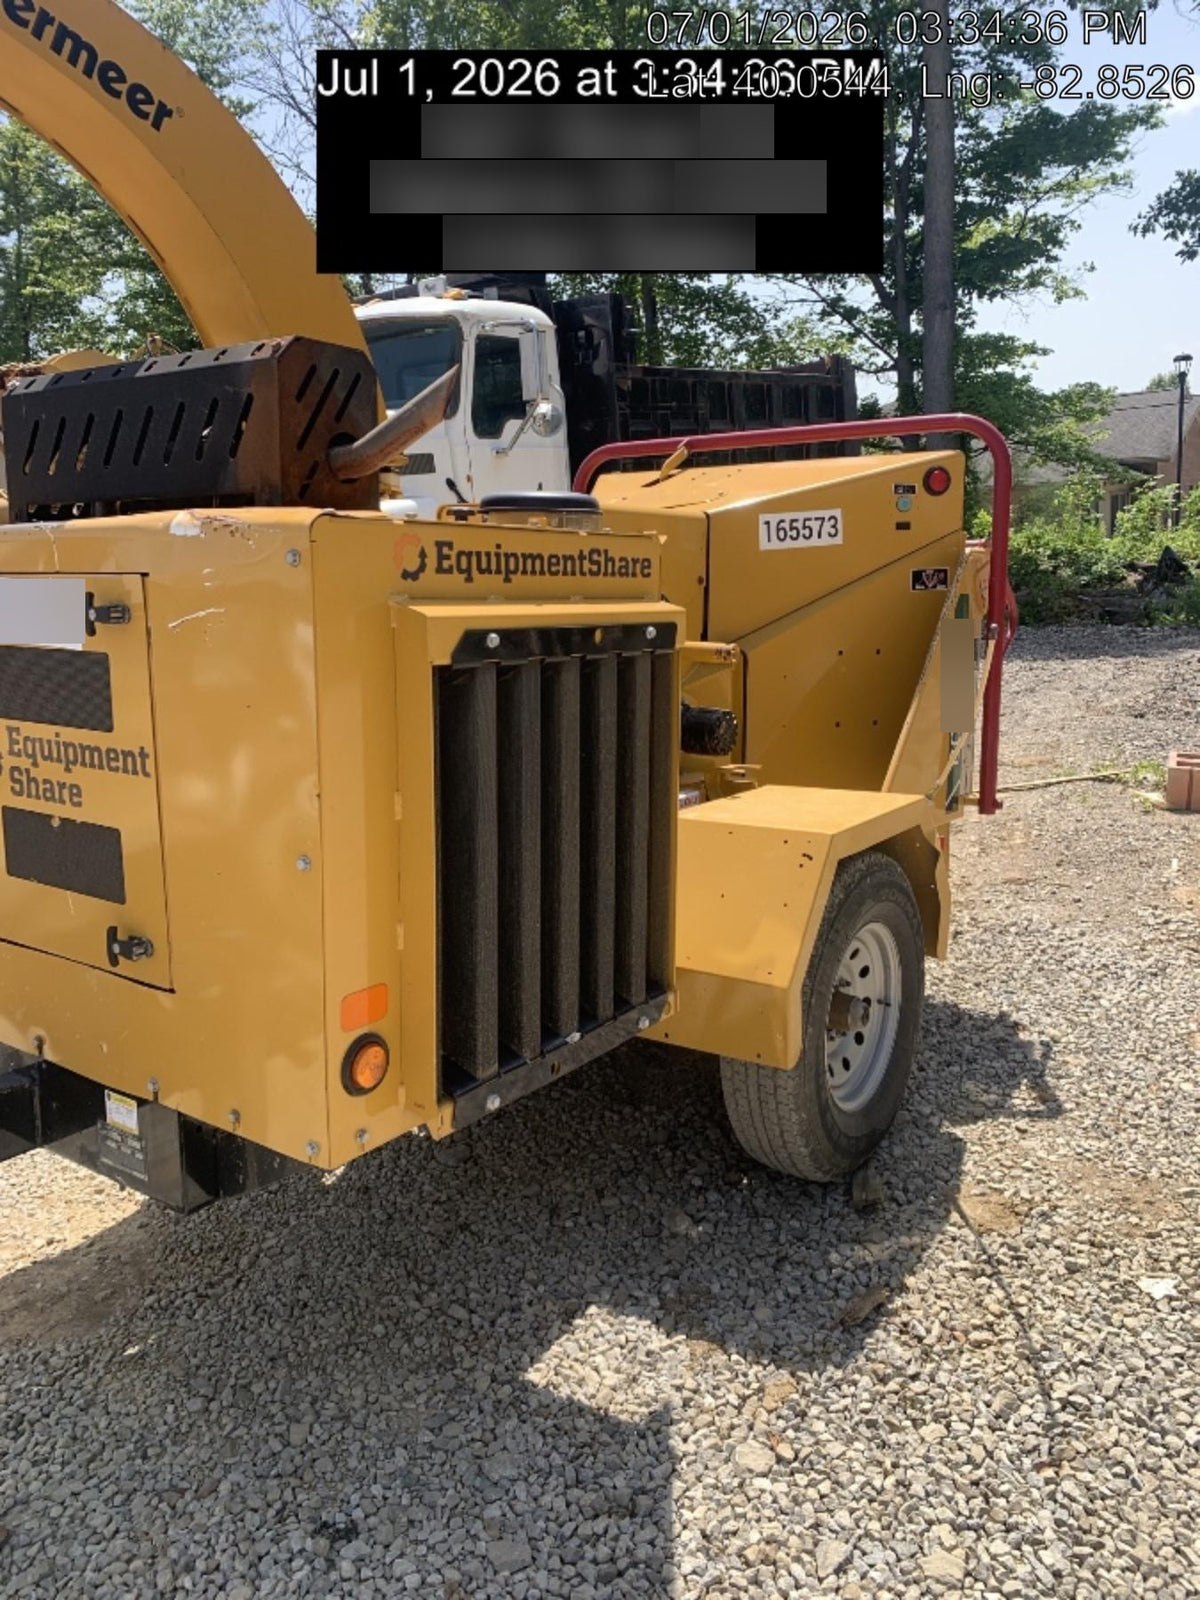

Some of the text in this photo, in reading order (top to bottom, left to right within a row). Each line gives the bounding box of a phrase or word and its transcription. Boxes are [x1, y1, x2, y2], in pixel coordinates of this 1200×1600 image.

[762, 514, 840, 544] 165573
[433, 539, 653, 584] EquipmentShare
[6, 724, 152, 779] Equipment
[9, 765, 83, 808] Share
